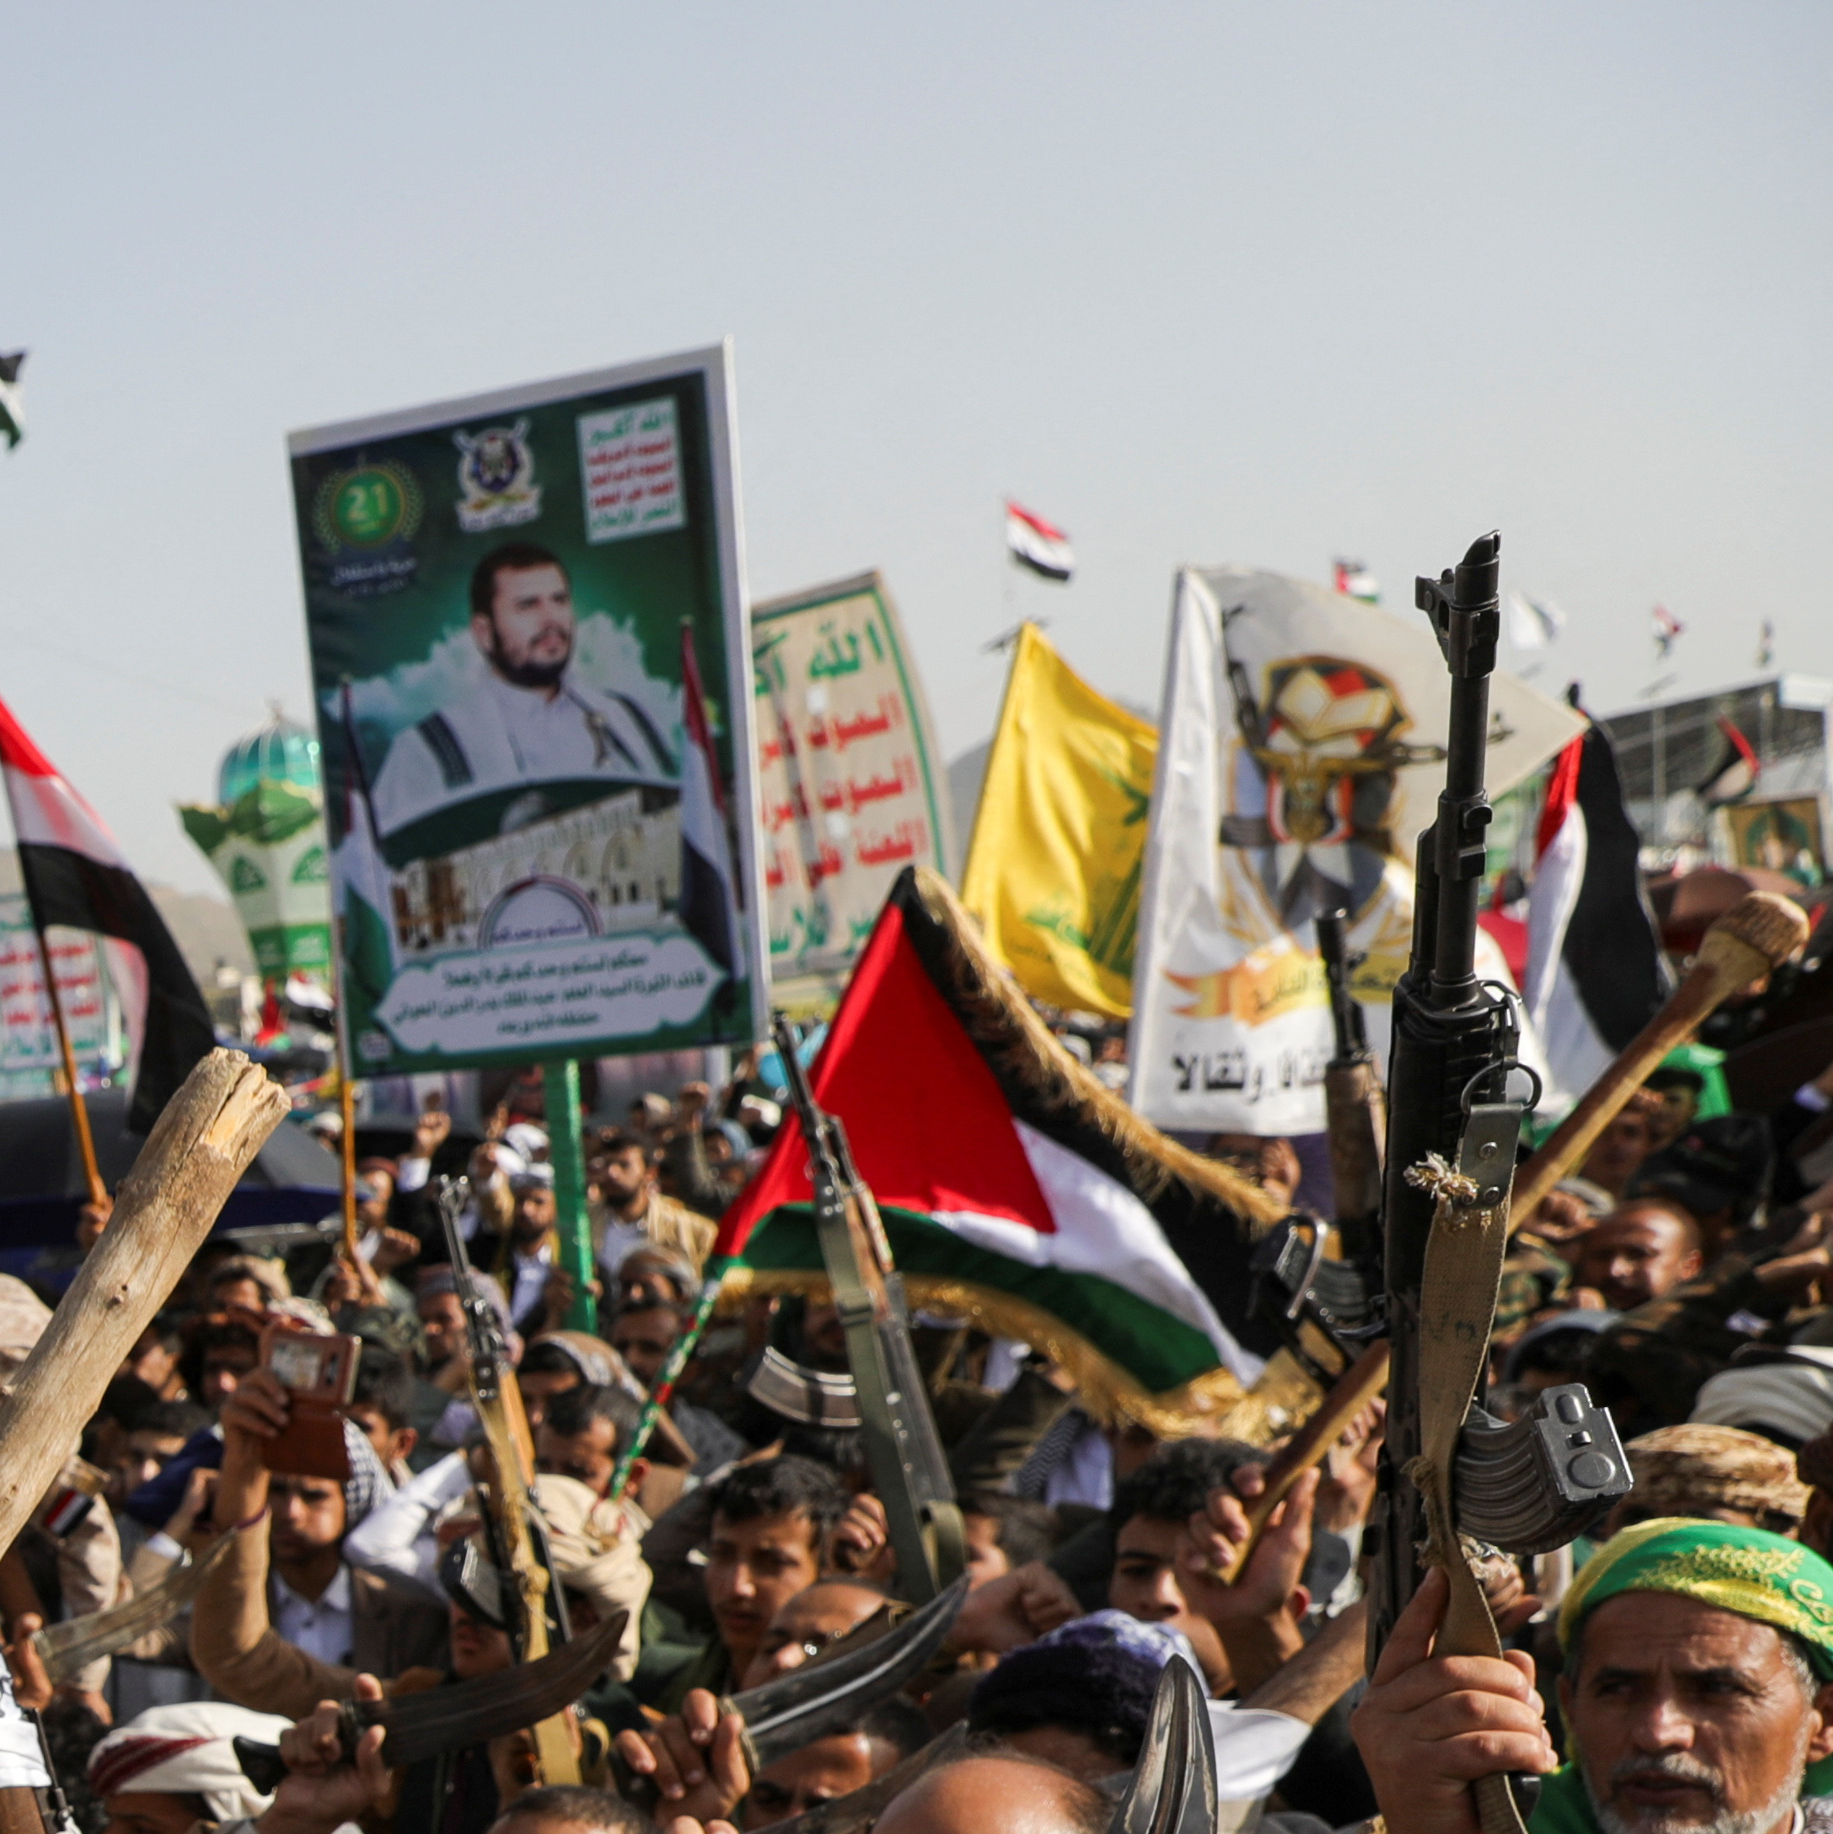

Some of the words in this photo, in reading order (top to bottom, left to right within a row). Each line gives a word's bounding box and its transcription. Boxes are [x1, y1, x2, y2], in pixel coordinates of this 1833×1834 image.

[346, 483, 389, 521] 21
[807, 617, 886, 680] الله
[808, 691, 901, 751] الموت
[818, 754, 917, 816] الموت
